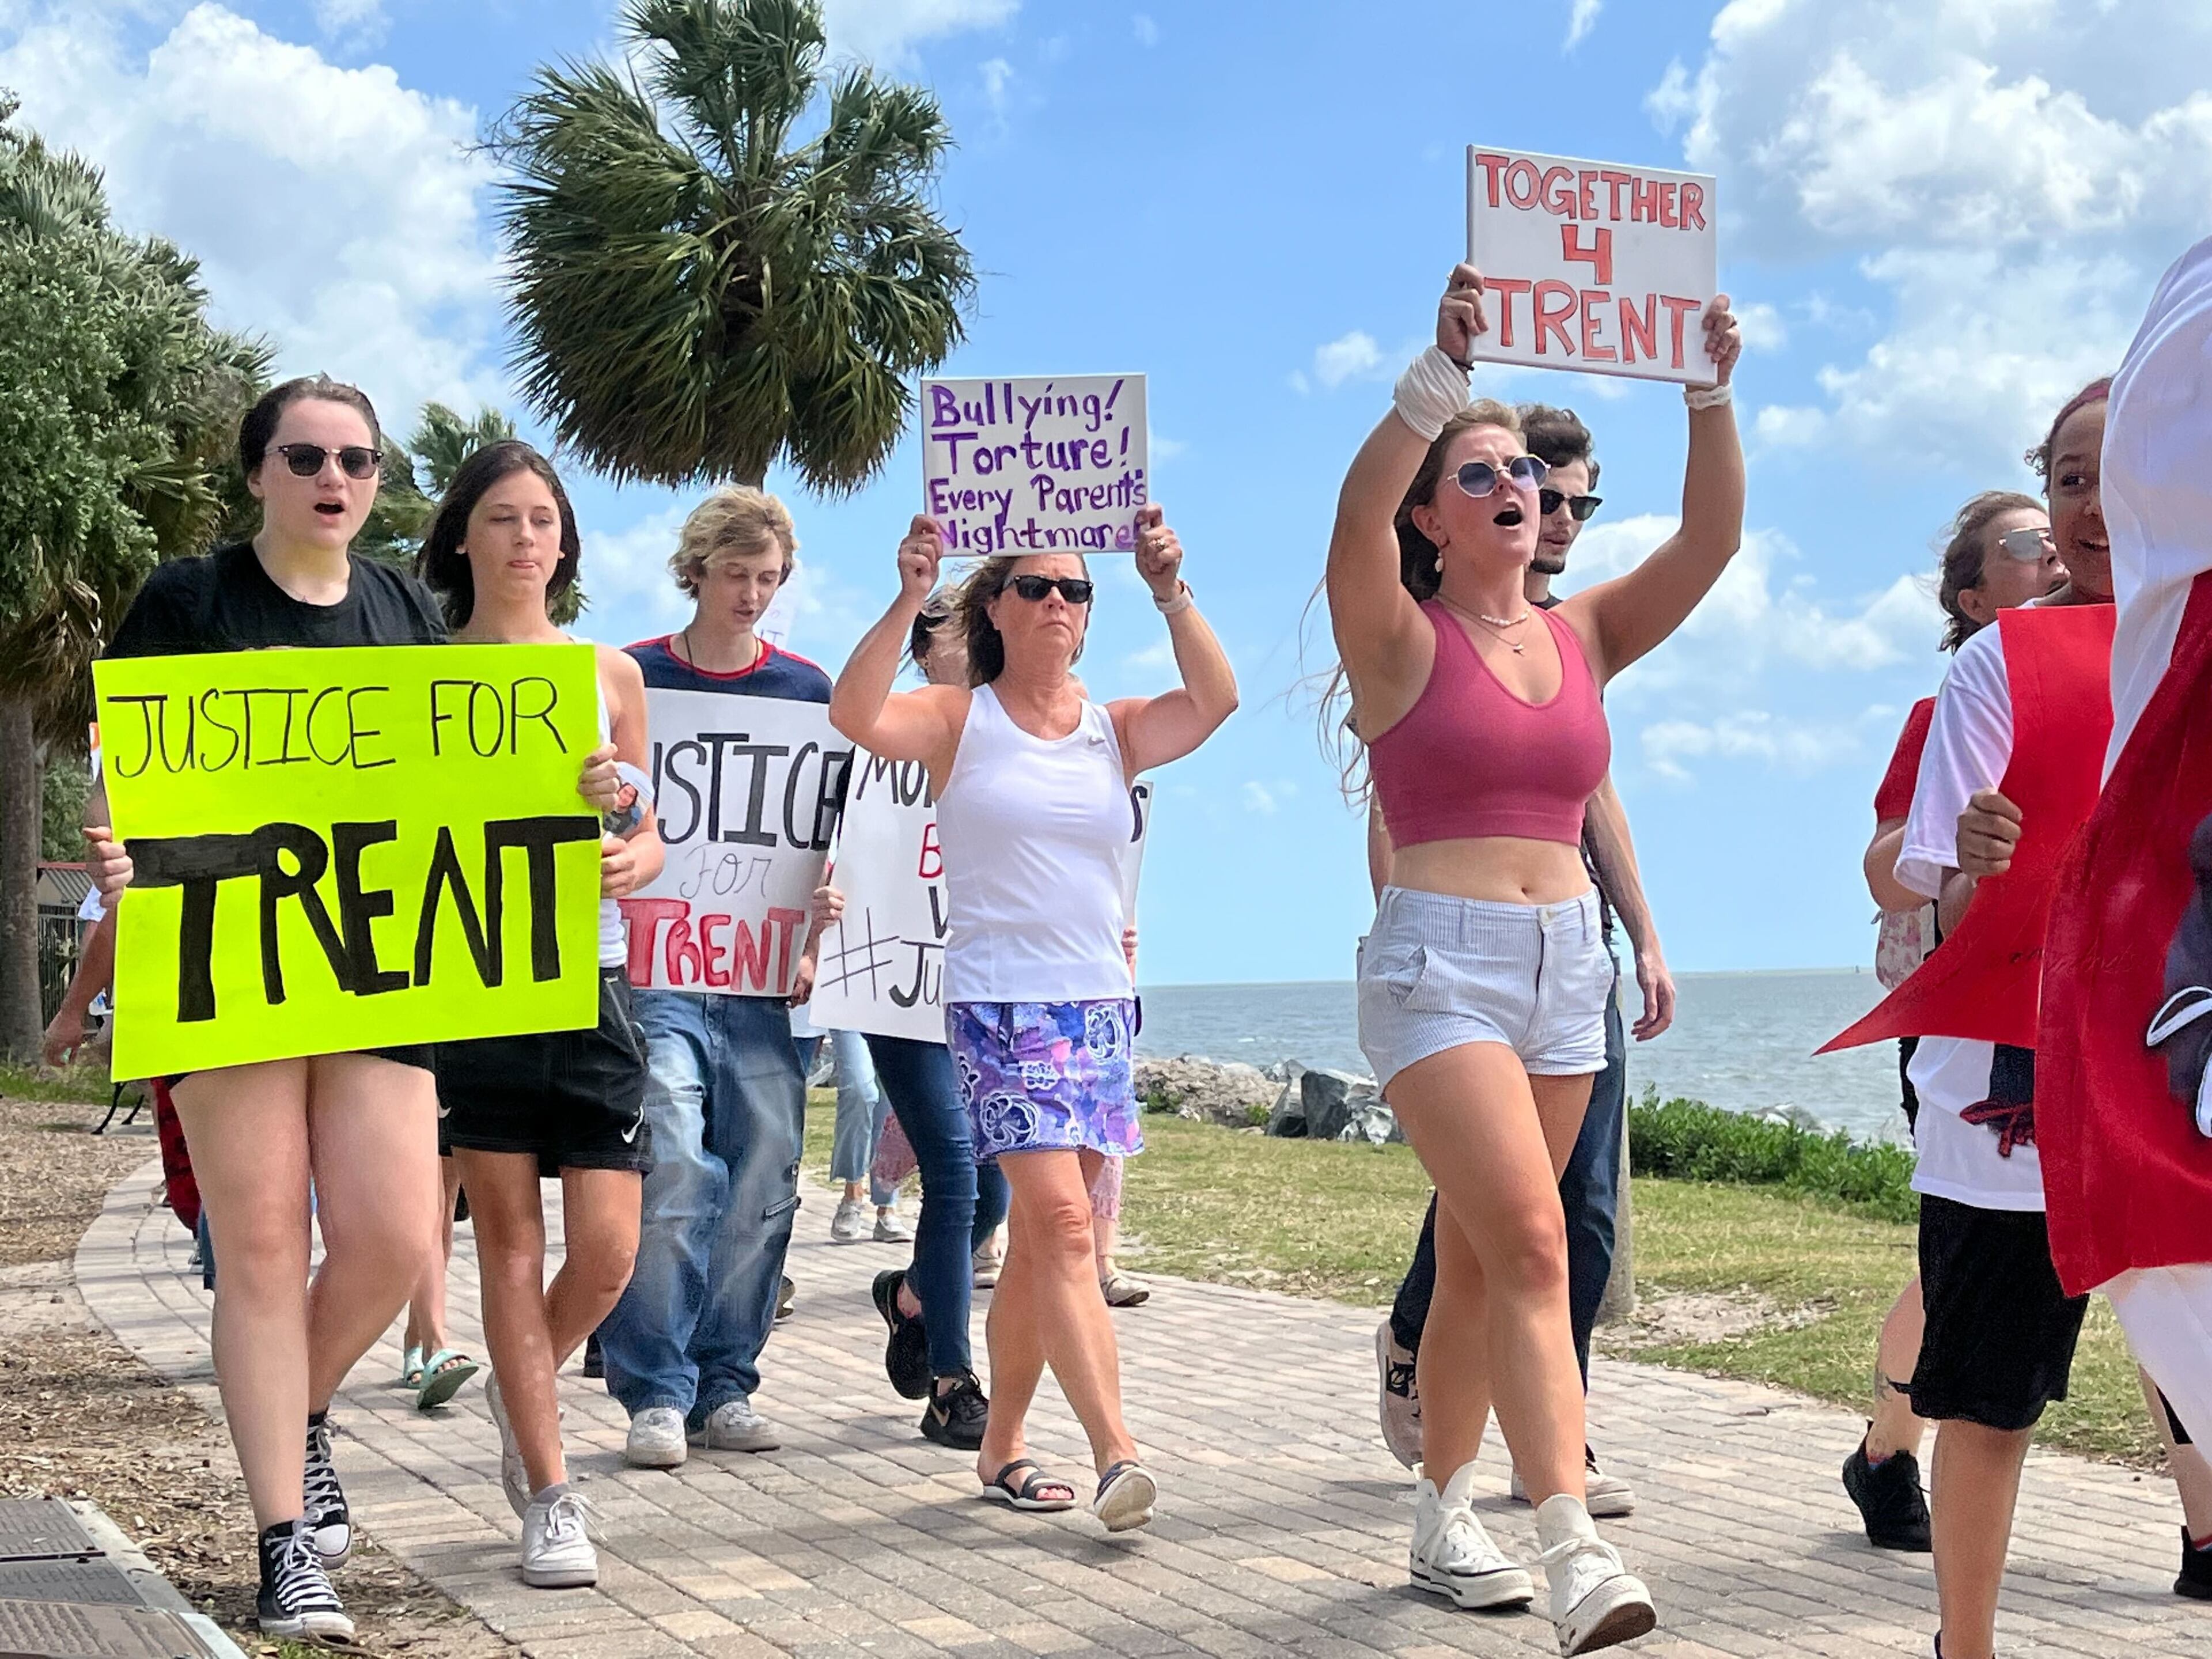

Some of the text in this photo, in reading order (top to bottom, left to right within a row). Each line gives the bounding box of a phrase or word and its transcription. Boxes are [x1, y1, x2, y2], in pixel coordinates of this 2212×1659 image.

[1476, 154, 1706, 230] TOGETHER
[1560, 224, 1612, 285] 4
[1484, 277, 1702, 369] TRENT
[930, 378, 1125, 432] Bullying!
[931, 426, 1130, 475] Torture!
[929, 478, 1014, 525] Every
[107, 676, 569, 778] JUSTICE FOR
[124, 815, 601, 1023] TRENT
[617, 897, 805, 994] TRENT
